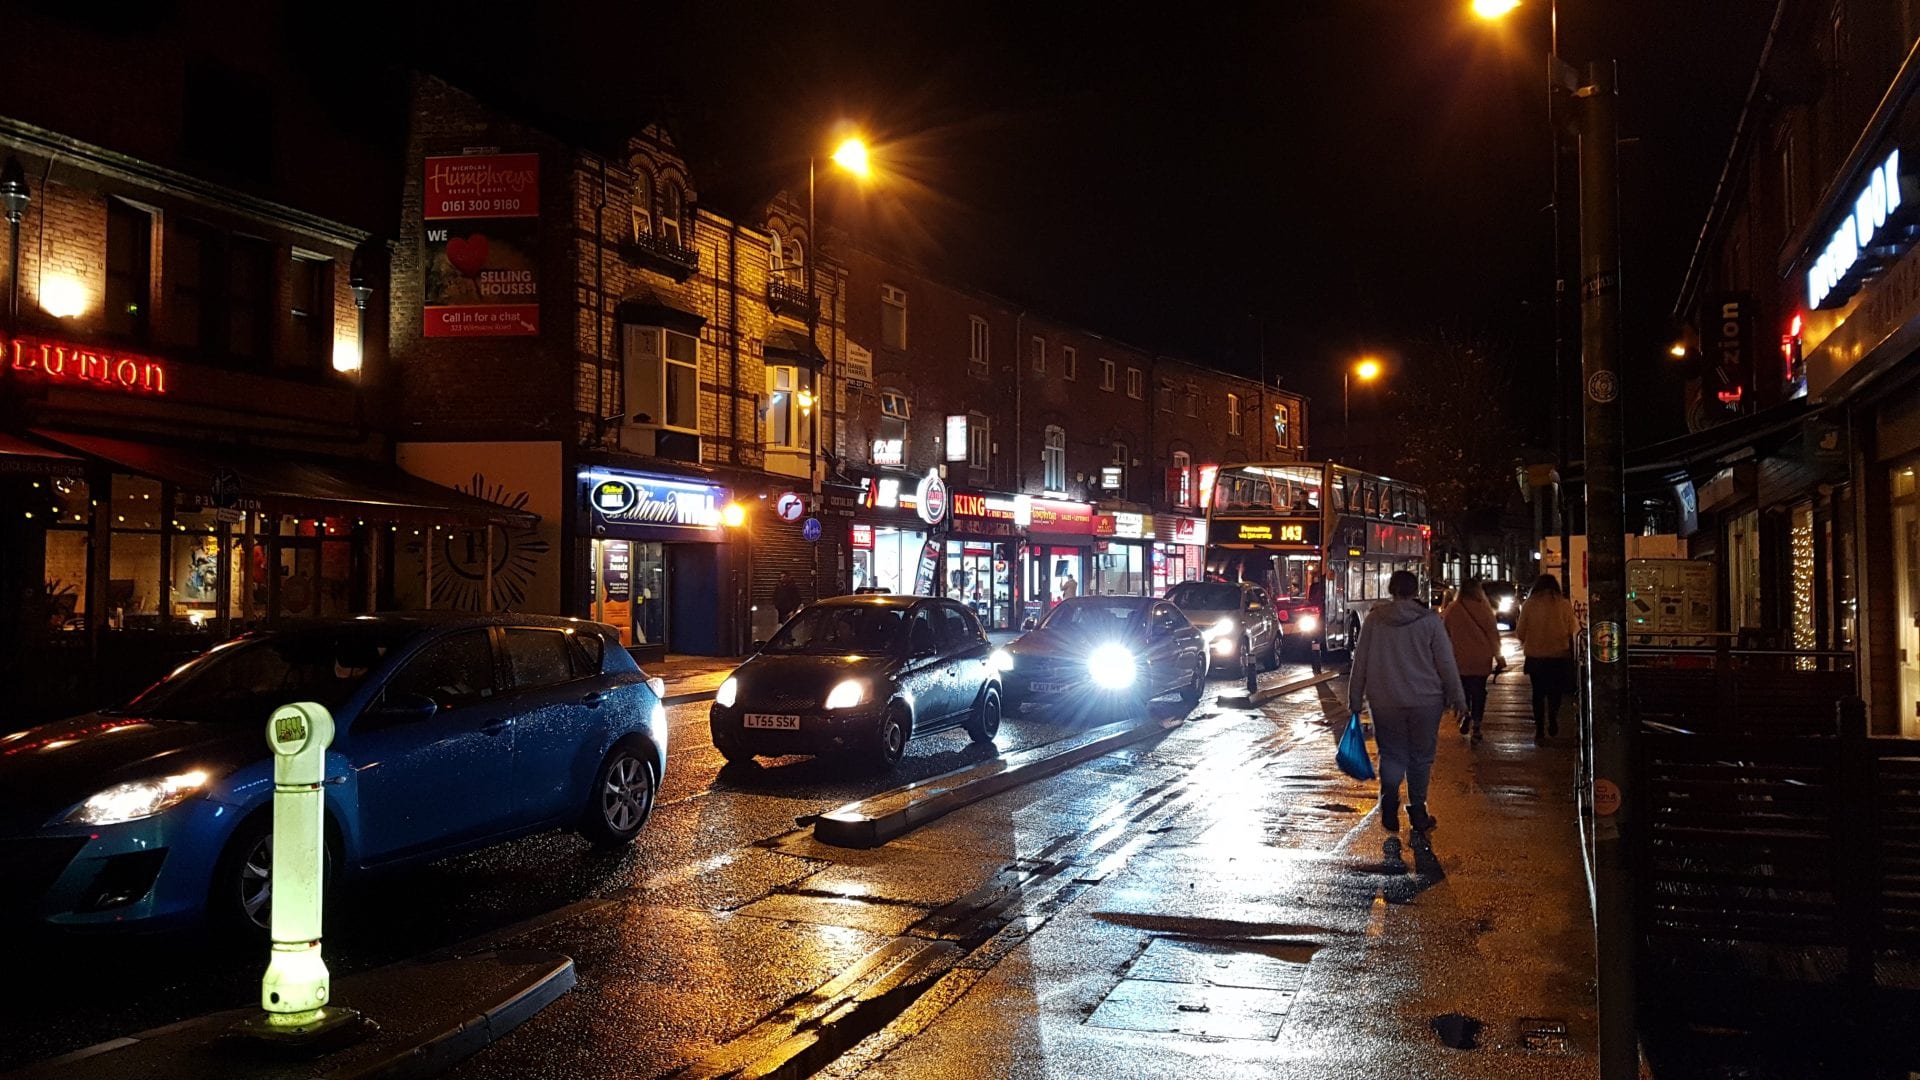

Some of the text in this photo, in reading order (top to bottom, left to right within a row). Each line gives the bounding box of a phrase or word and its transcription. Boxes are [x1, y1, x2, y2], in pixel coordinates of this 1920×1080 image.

[428, 162, 535, 196] Humphreys
[442, 198, 521, 212] 0161 300 9180
[427, 229, 448, 242] WE
[480, 270, 532, 283] SELLING
[480, 282, 537, 296] HOUSES!
[442, 311, 521, 323] Call in for a chat
[0, 338, 166, 393] LUTION
[954, 493, 985, 517] KING
[1280, 525, 1302, 541] 143
[748, 716, 796, 728] LT55 SSK
